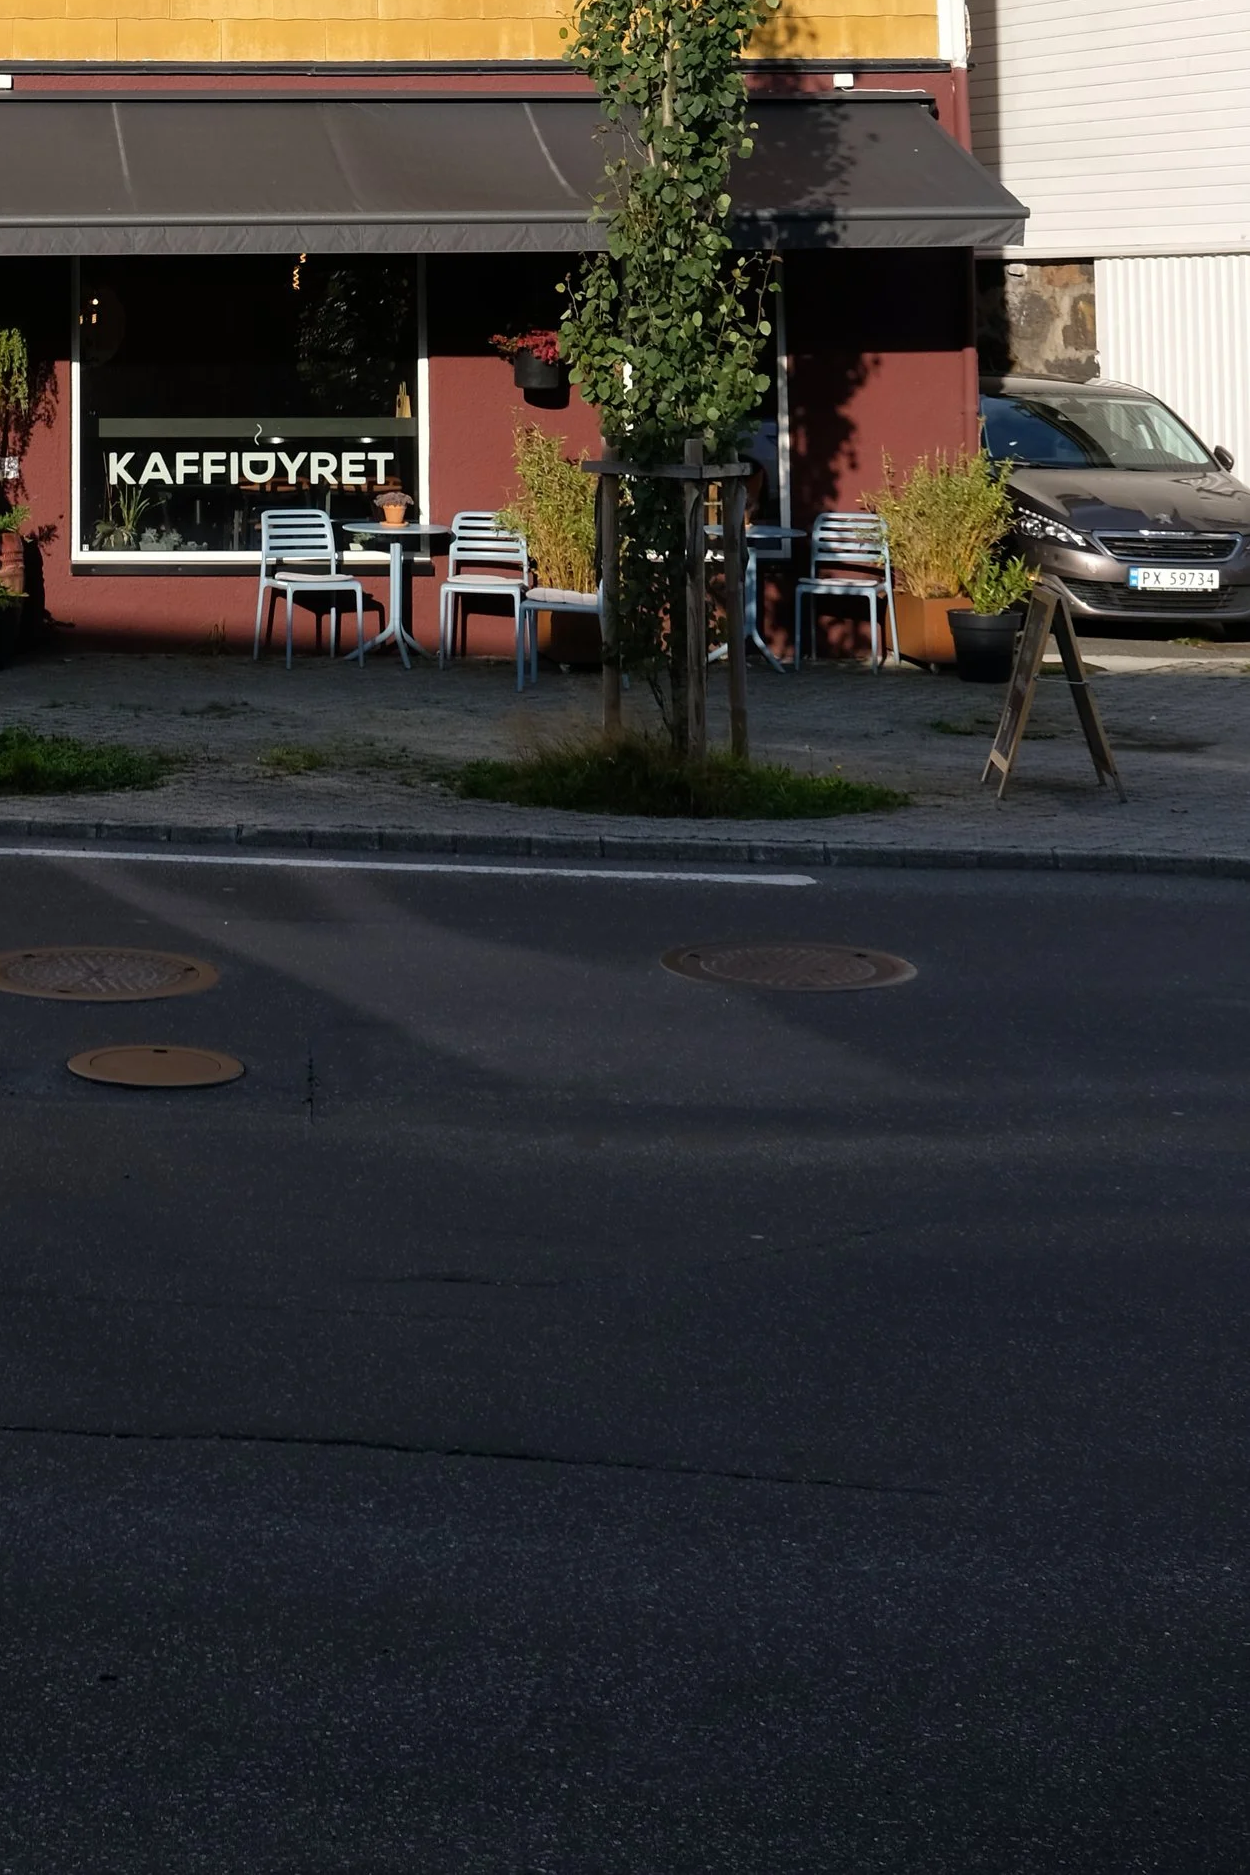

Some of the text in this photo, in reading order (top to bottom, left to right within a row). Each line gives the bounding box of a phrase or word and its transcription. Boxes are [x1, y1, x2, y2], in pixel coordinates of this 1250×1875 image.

[109, 451, 395, 485] KAFFIDYRET
[1142, 571, 1214, 586] PX 59734
